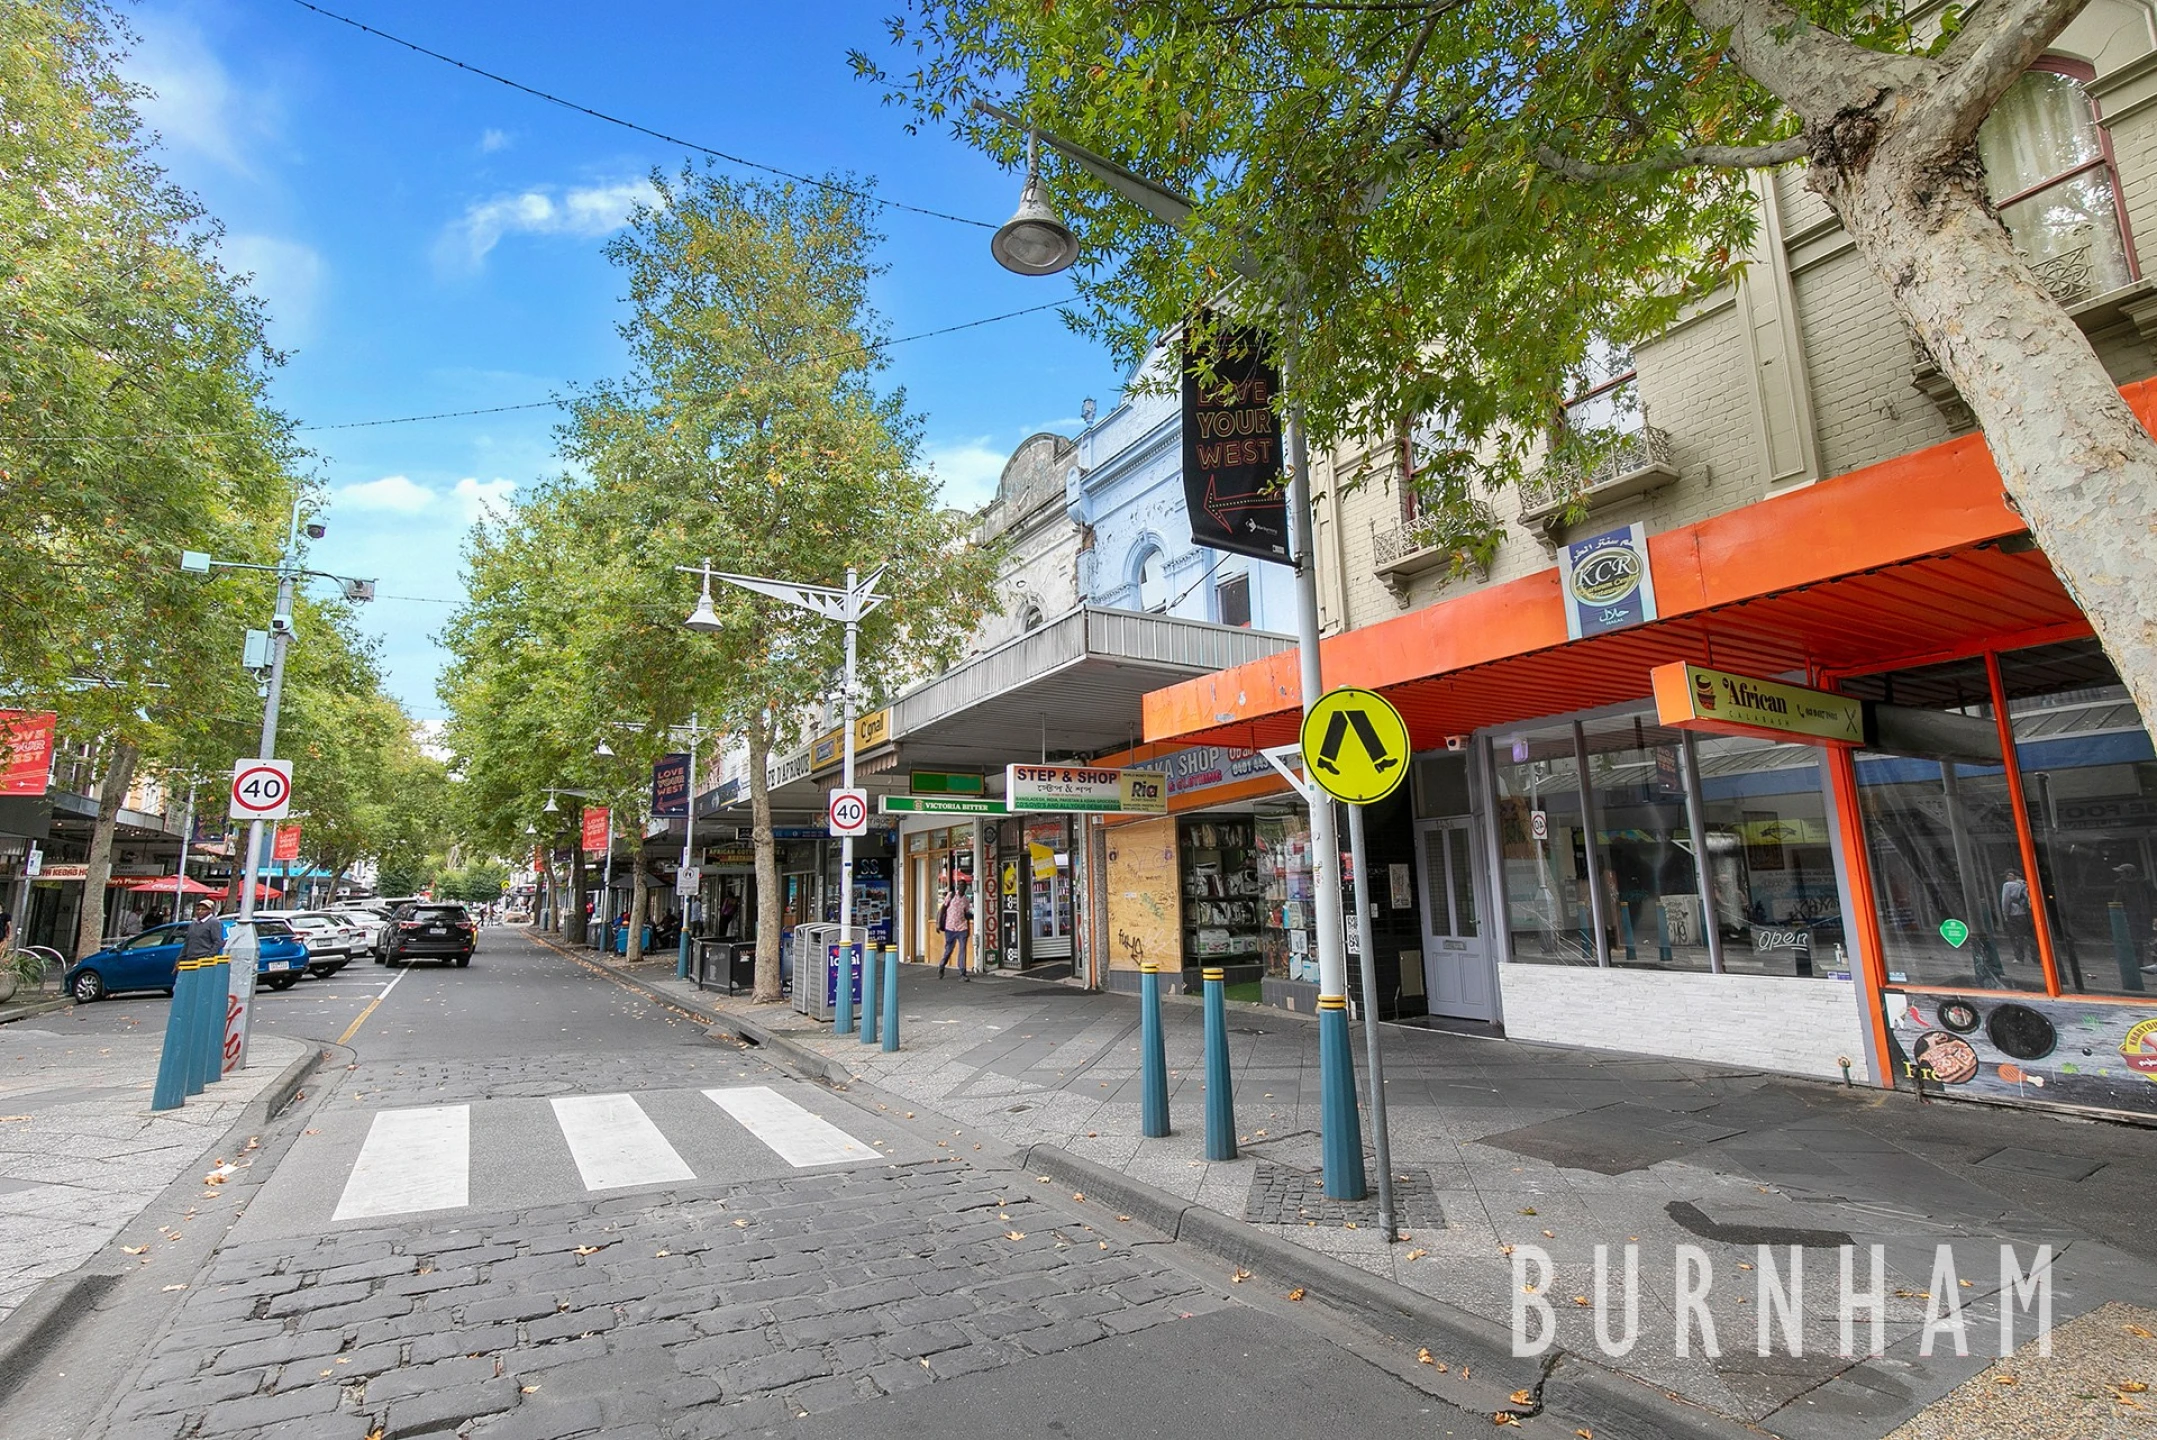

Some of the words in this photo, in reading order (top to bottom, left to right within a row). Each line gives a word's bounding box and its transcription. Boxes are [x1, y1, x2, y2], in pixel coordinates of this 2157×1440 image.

[1196, 409, 1272, 438] YOUR
[1196, 438, 1273, 470] WEST
[1576, 555, 1639, 586] KCR
[1728, 680, 1788, 714] African
[1729, 710, 1789, 726] CALABASH
[1178, 746, 1220, 776] SHOP
[658, 767, 684, 778] LOVE
[1017, 768, 1056, 781] STEP
[1062, 771, 1072, 782] &
[1077, 771, 1117, 784] SHOP
[1176, 769, 1223, 790] CLOTHING
[243, 780, 280, 798] 40
[656, 783, 684, 796] WEST
[1065, 784, 1073, 793] &
[1132, 781, 1158, 798] Ria
[836, 804, 860, 819] 40
[925, 802, 960, 810] VICTORIA
[962, 803, 988, 811] BITTER
[984, 845, 998, 949] LIQUOR
[1758, 930, 1807, 951] open
[829, 954, 860, 967] loal
